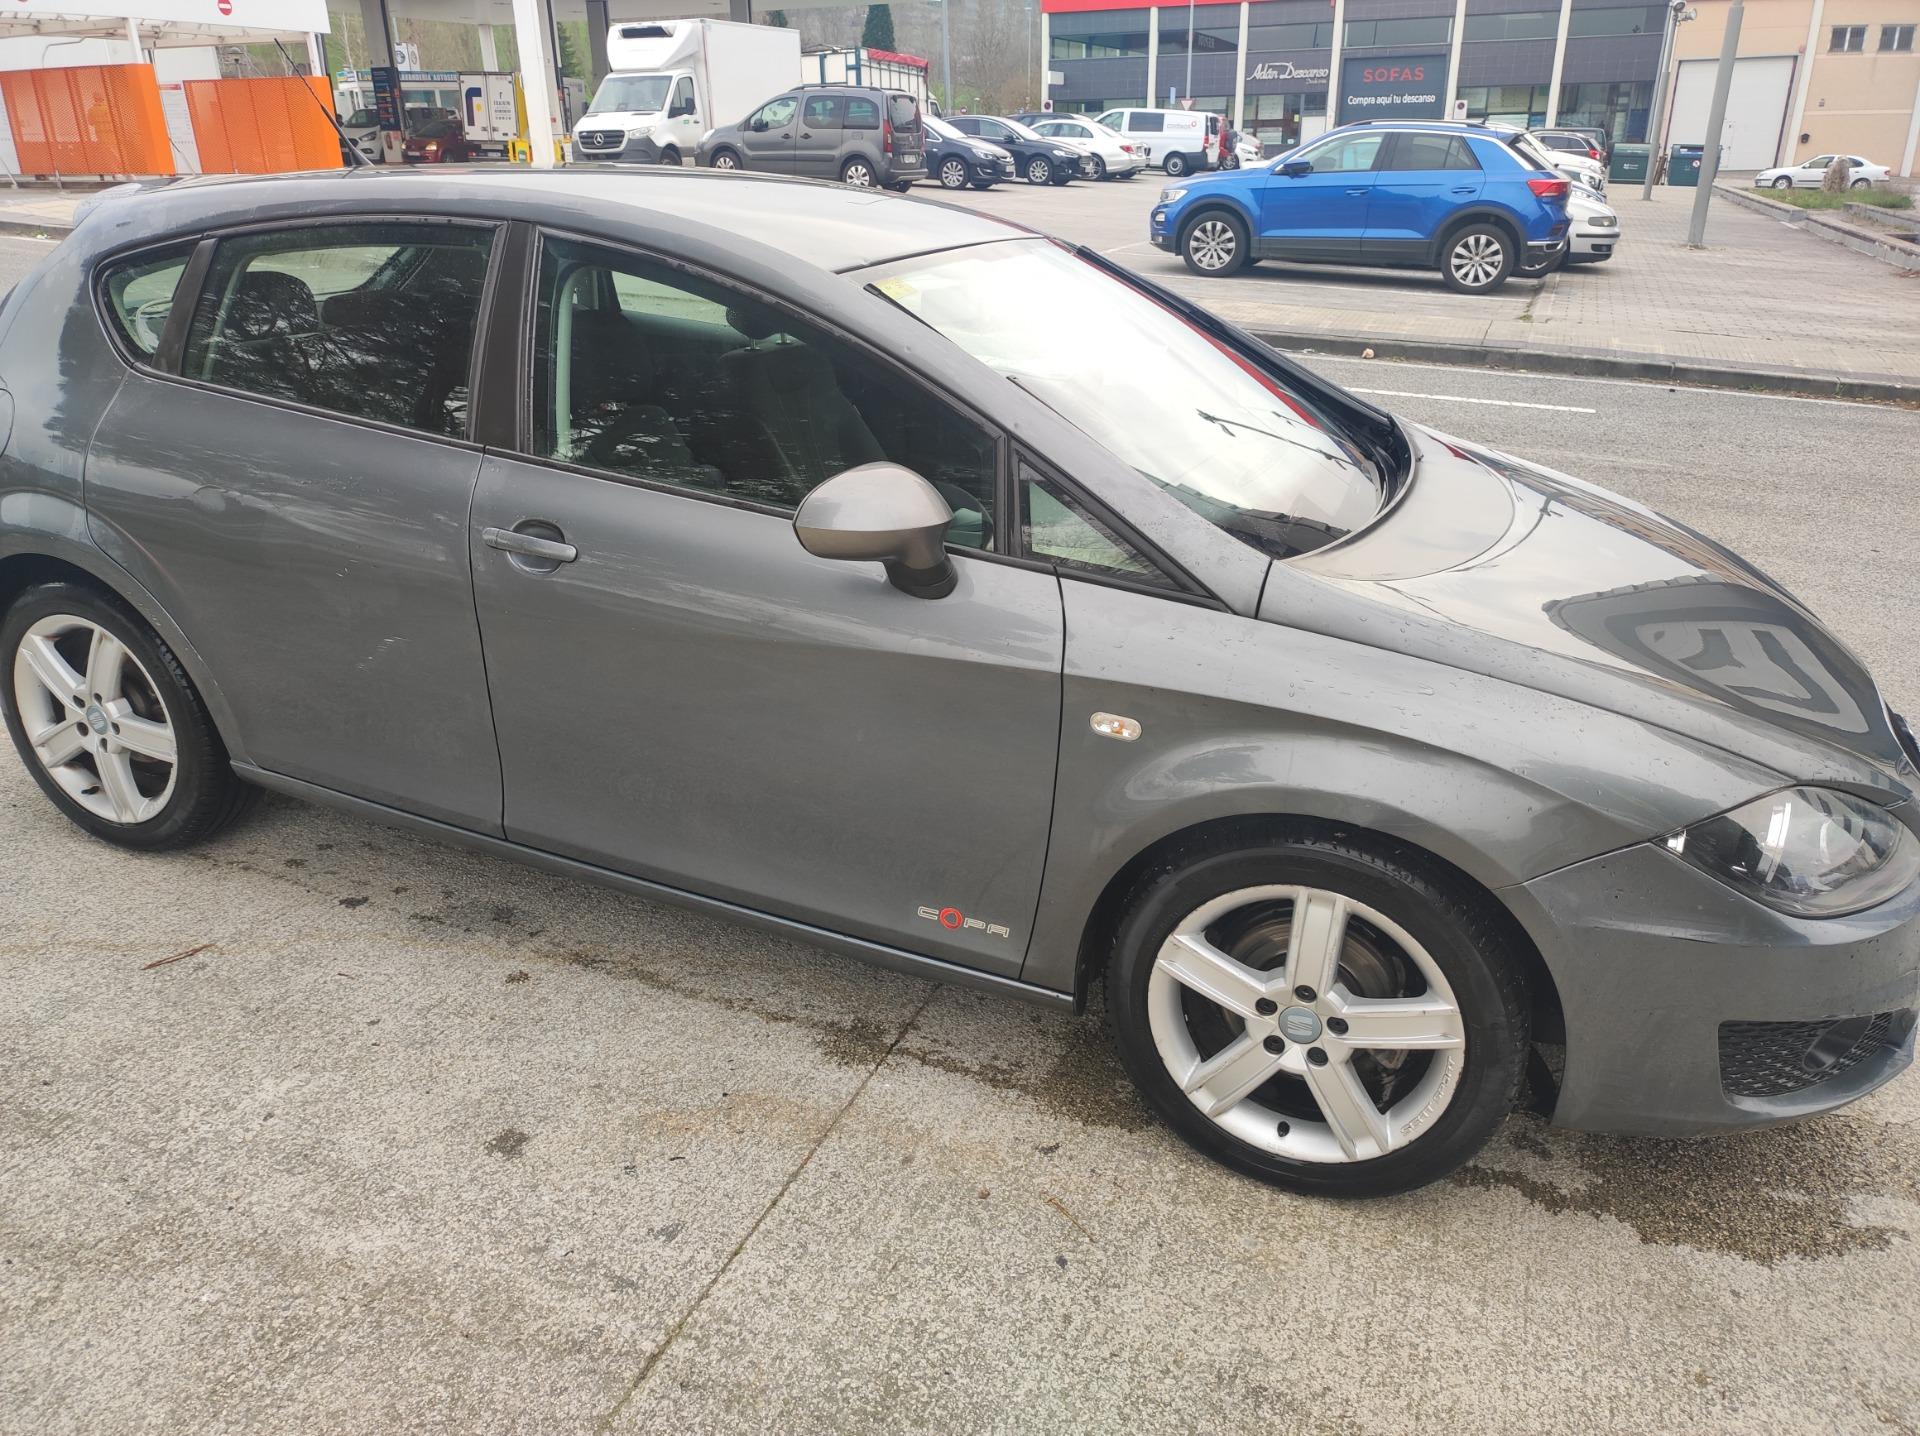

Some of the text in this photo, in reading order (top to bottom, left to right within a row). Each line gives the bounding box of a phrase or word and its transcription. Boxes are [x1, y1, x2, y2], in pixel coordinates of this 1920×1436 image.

[1278, 62, 1329, 79] Descanso
[1363, 66, 1424, 83] SOFAS
[1347, 93, 1436, 107] Compra aquí tu descanso
[917, 905, 1010, 938] COPA
[1400, 1055, 1456, 1137] SEAT SPORT
